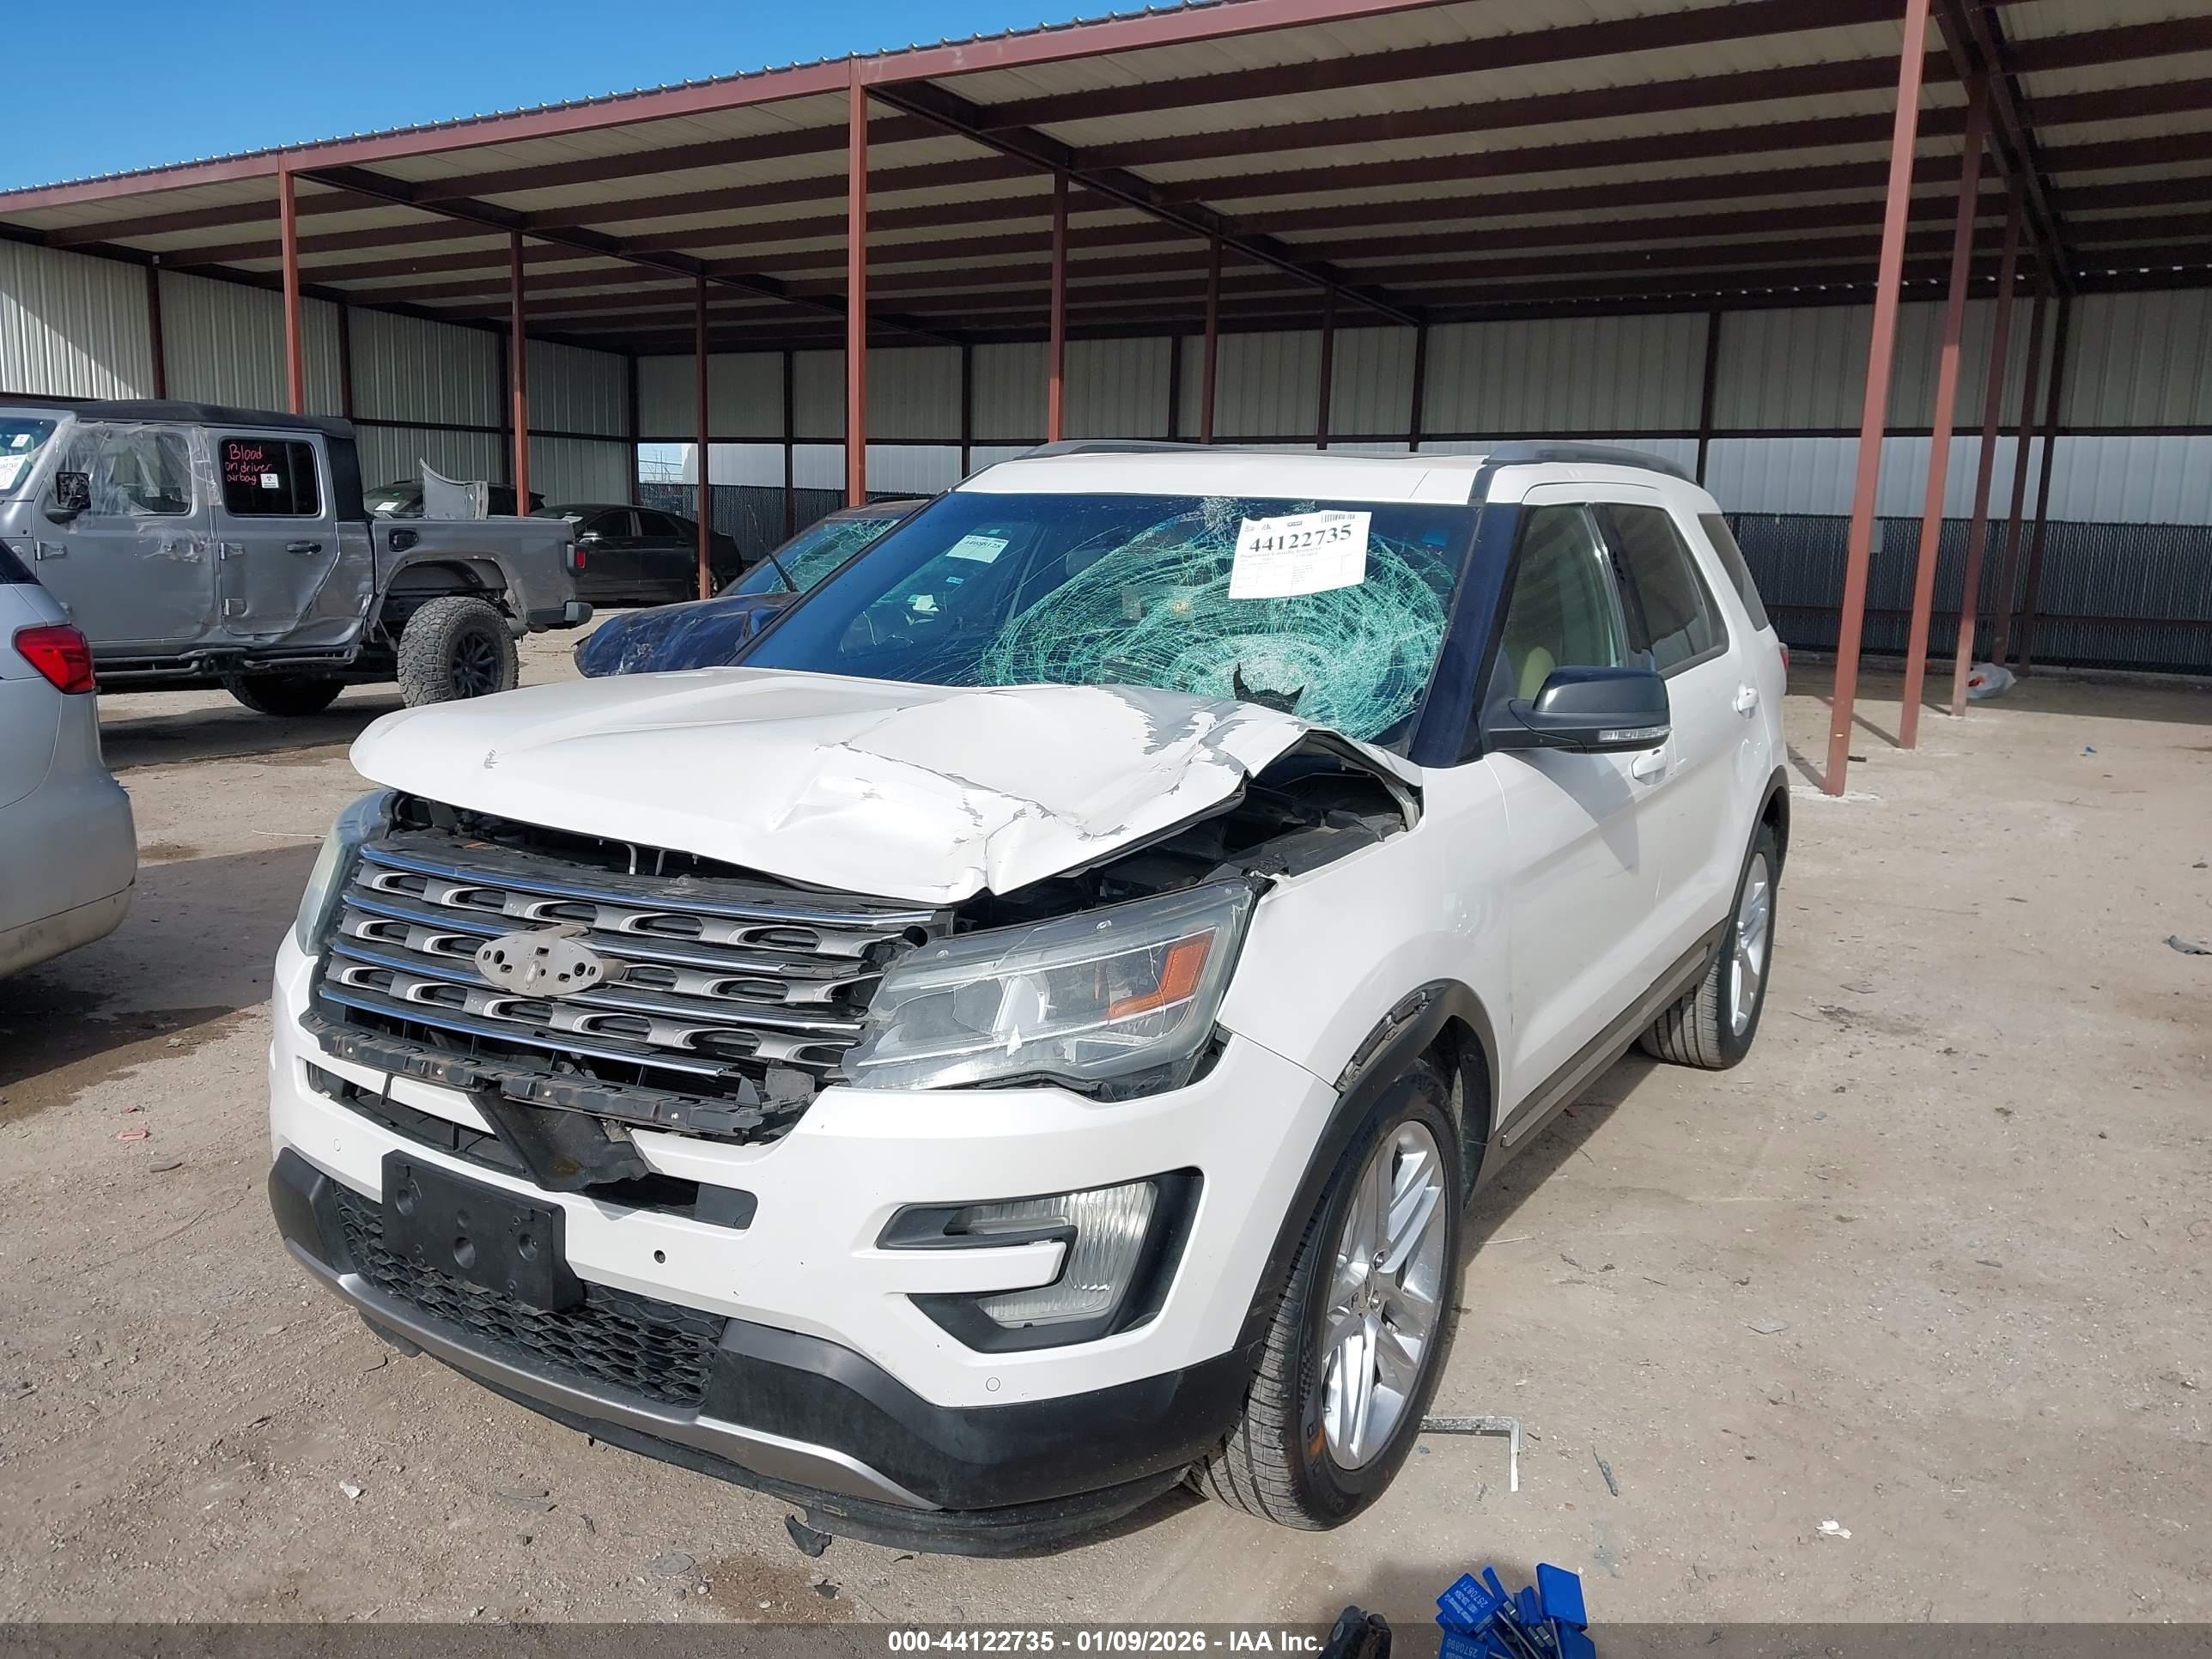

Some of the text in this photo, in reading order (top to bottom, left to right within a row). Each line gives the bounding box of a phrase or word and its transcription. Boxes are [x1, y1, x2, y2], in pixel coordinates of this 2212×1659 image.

[228, 443, 263, 460] Blood
[225, 461, 272, 473] on driver
[227, 471, 257, 486] airbag
[1249, 524, 1352, 552] 44122735
[1461, 1580, 1489, 1608] 2570871
